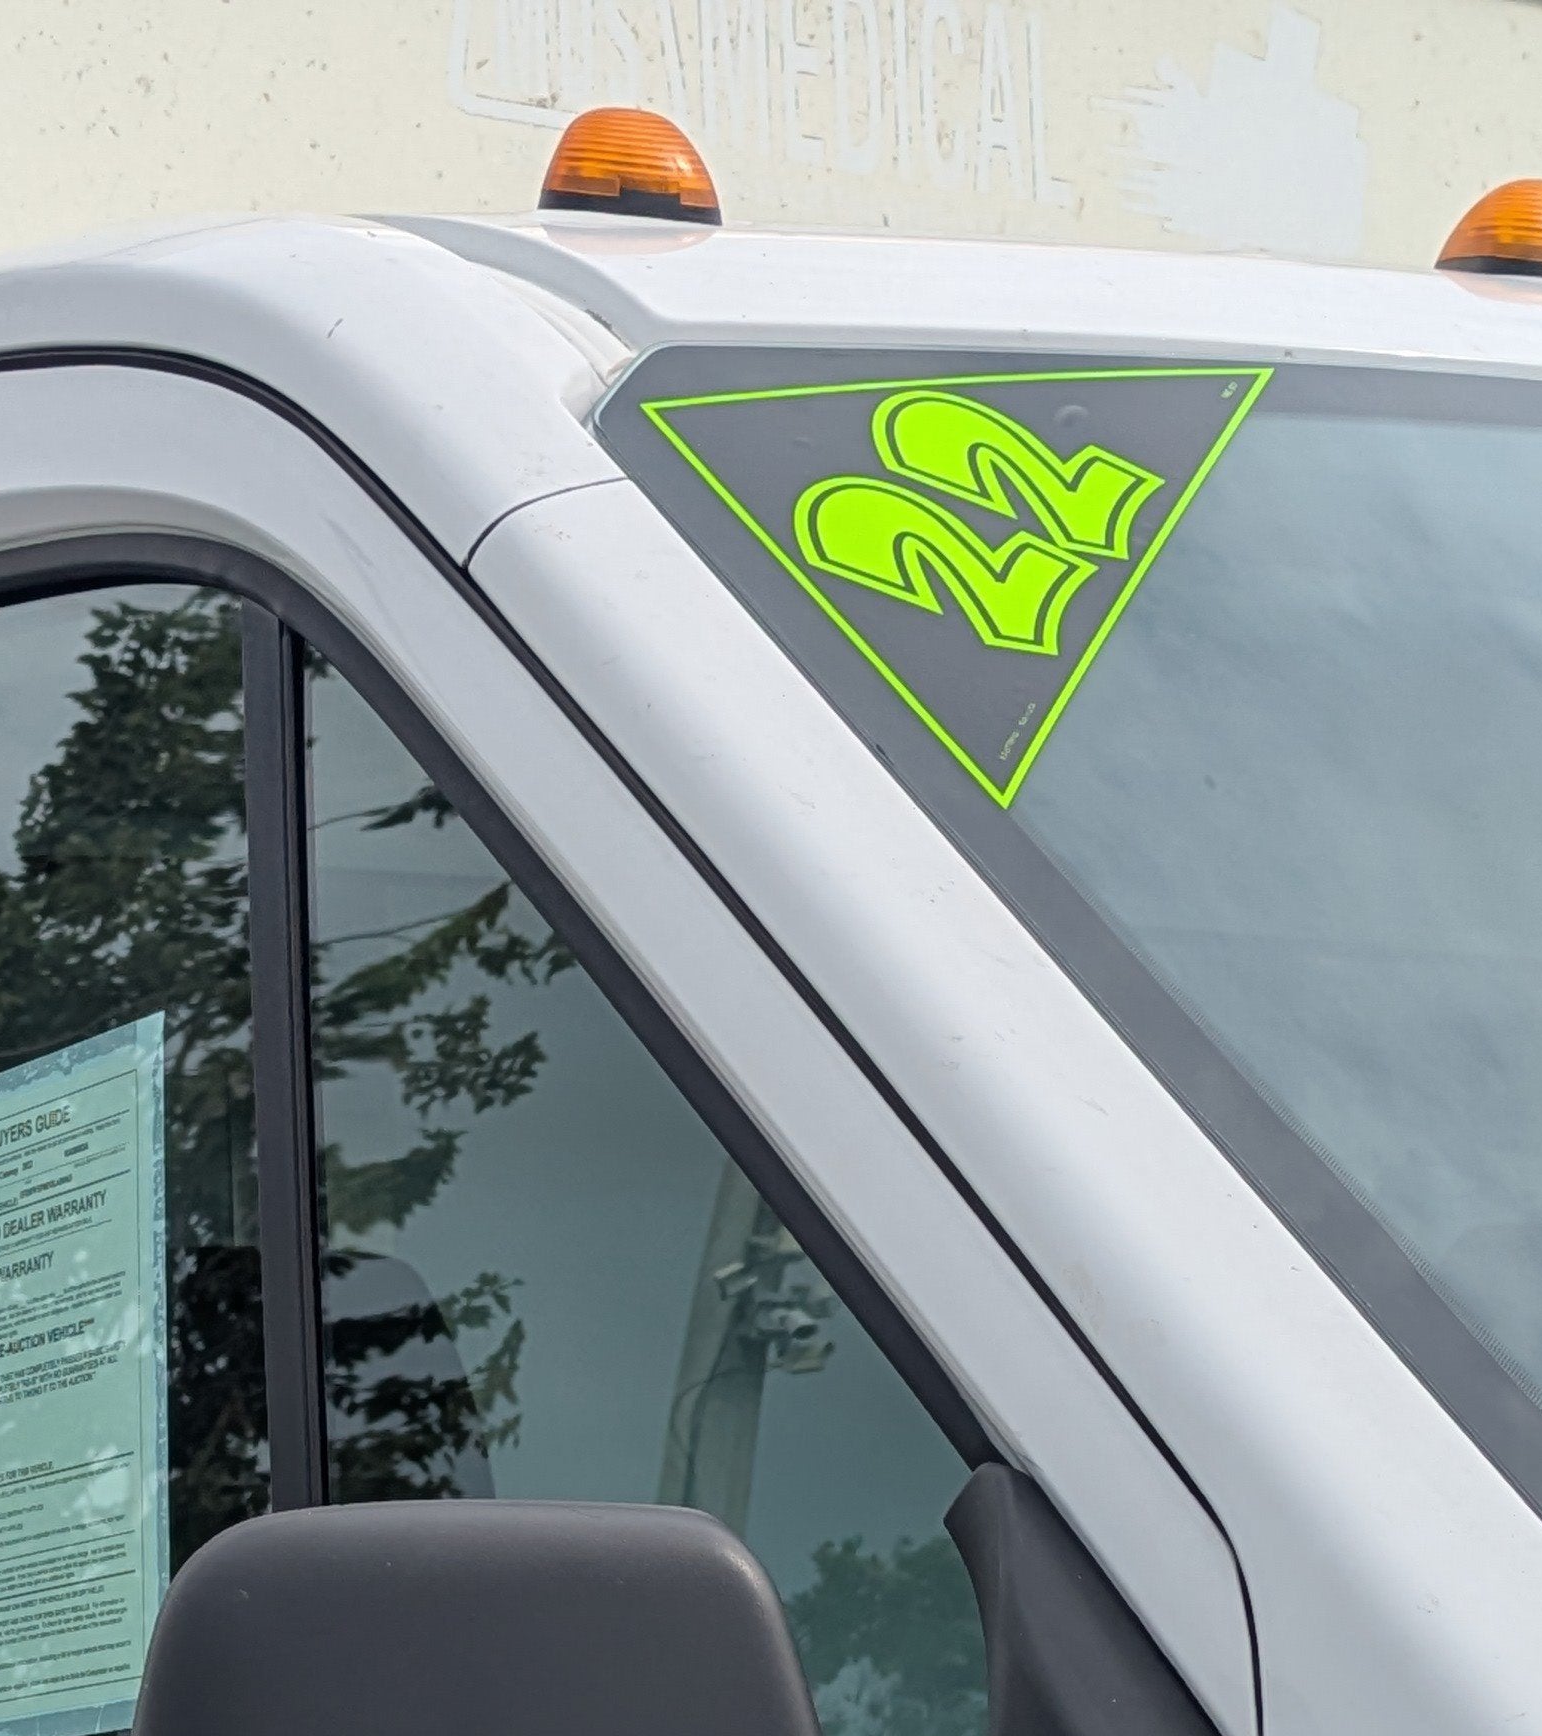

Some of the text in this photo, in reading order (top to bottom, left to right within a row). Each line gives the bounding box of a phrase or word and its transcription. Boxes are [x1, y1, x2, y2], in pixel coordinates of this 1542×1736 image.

[794, 391, 1165, 655] 22
[35, 1105, 71, 1134] GUIDE
[3, 1210, 44, 1239] DEALER
[47, 1188, 107, 1223] WARRANTY
